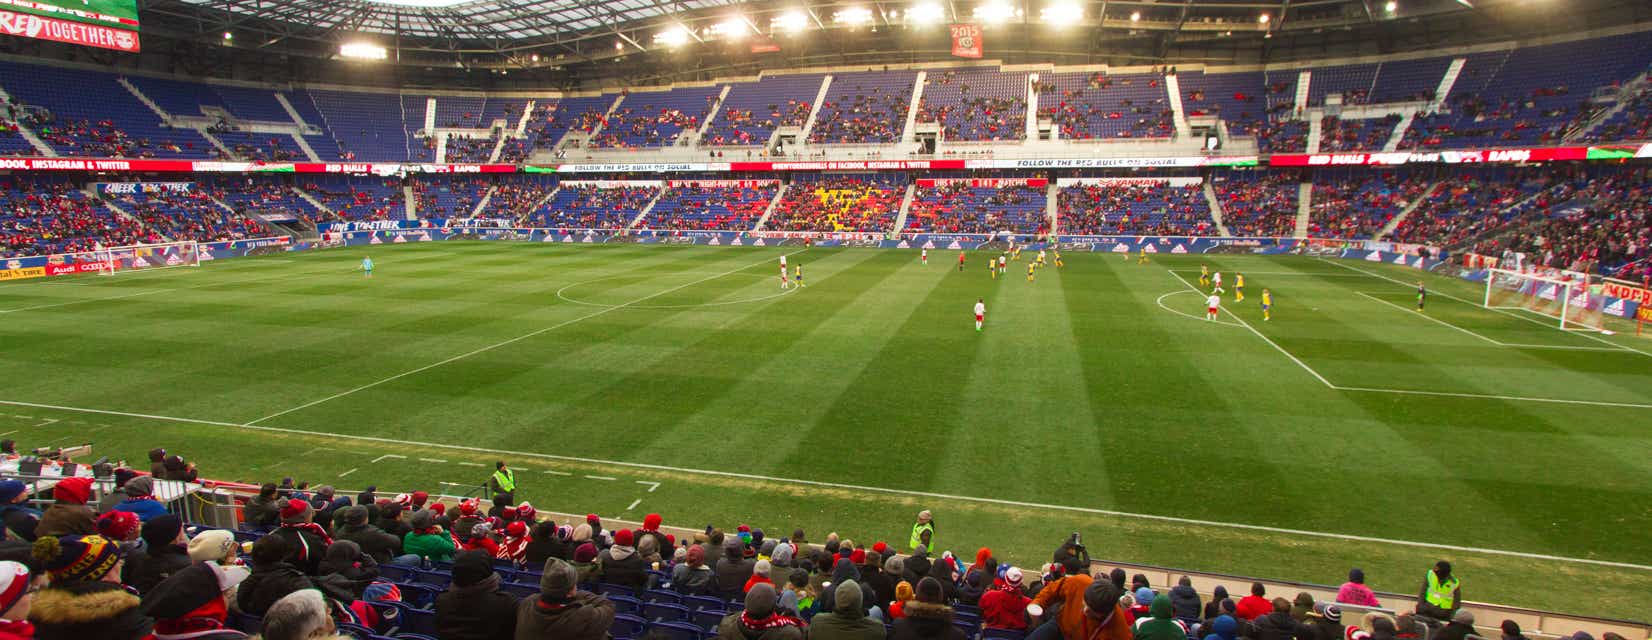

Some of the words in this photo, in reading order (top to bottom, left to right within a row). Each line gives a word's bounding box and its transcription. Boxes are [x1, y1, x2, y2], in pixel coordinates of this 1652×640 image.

[952, 26, 978, 37] 2015
[1488, 150, 1530, 161] RAPIDS
[32, 160, 85, 169] INSTAGRAM
[87, 161, 94, 169] &
[96, 161, 130, 170] TWITTER
[325, 164, 341, 172] RED
[343, 164, 368, 172] BULLS
[907, 161, 930, 169] TWITTER
[53, 266, 75, 275] Audi
